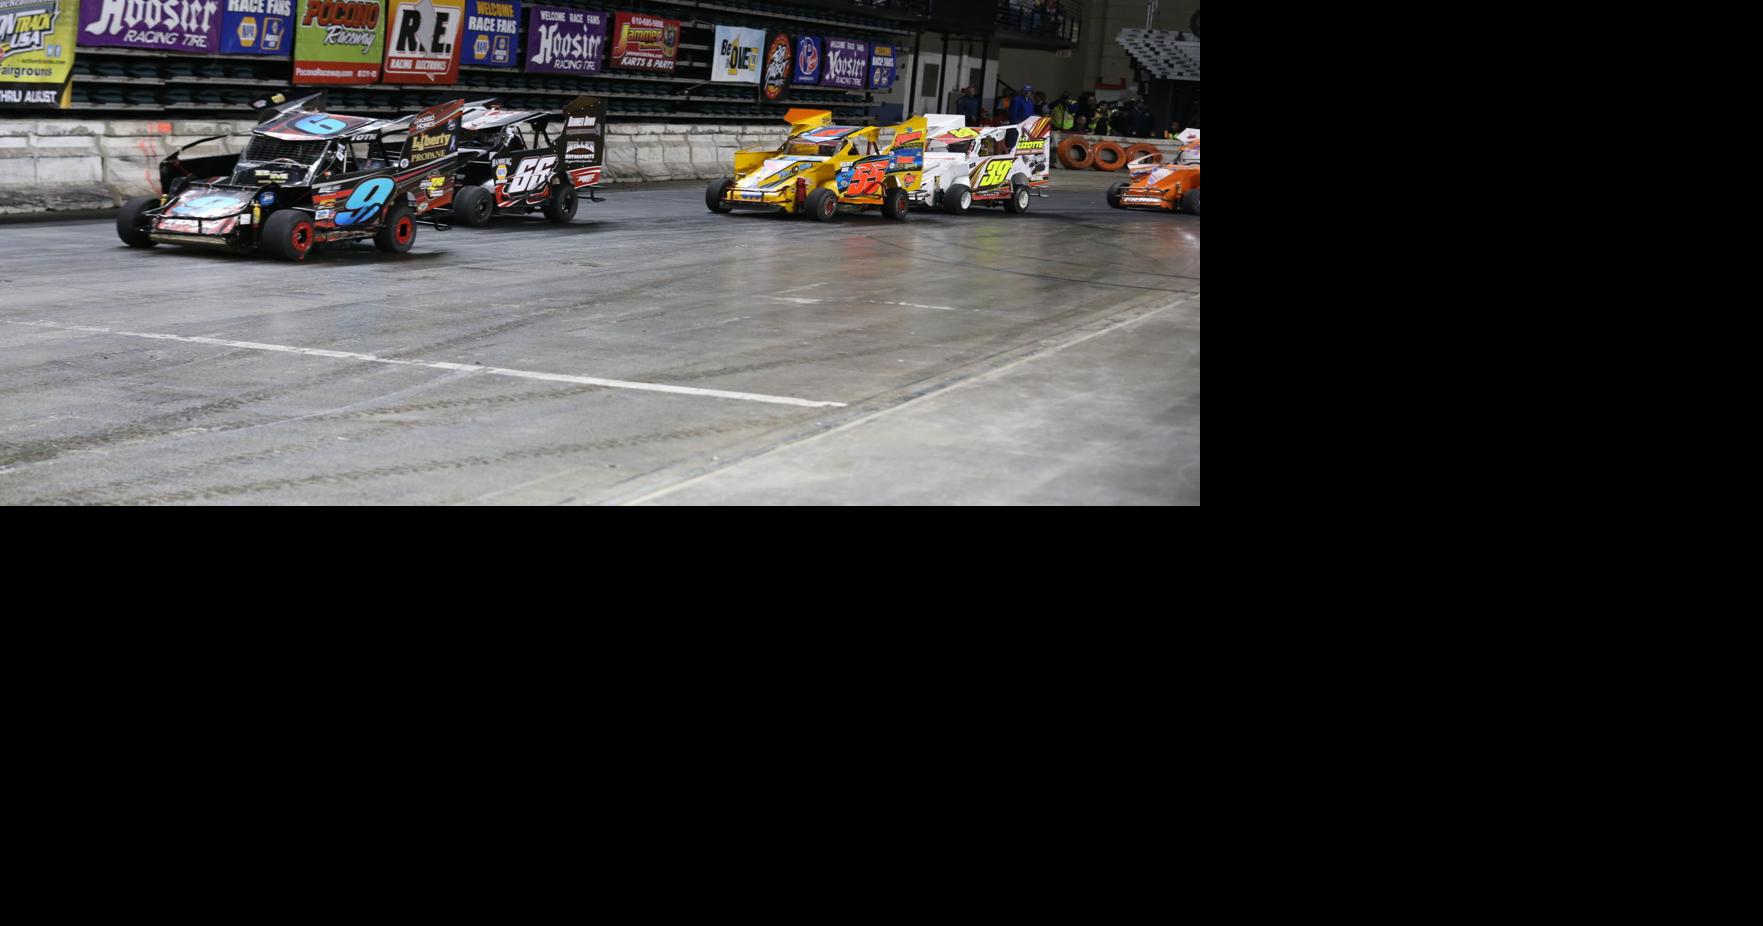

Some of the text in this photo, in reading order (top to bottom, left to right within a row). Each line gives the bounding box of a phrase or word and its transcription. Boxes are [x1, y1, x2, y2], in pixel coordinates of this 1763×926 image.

[228, 0, 291, 16] RACE FANS
[302, 0, 379, 29] POCONO
[477, 2, 513, 16] WELCOME
[540, 10, 566, 22] WELCOME
[569, 13, 583, 23] RACE
[85, 0, 217, 35] Hoosier
[468, 16, 518, 34] RACE FANS
[10, 31, 40, 48] USA
[124, 30, 207, 48] RACING TIRE
[532, 22, 601, 64] Hoosier
[554, 59, 582, 70] RACING
[621, 57, 645, 66] KARTS
[508, 156, 556, 194] 66
[979, 160, 1013, 187] 39
[335, 177, 395, 225] 9
